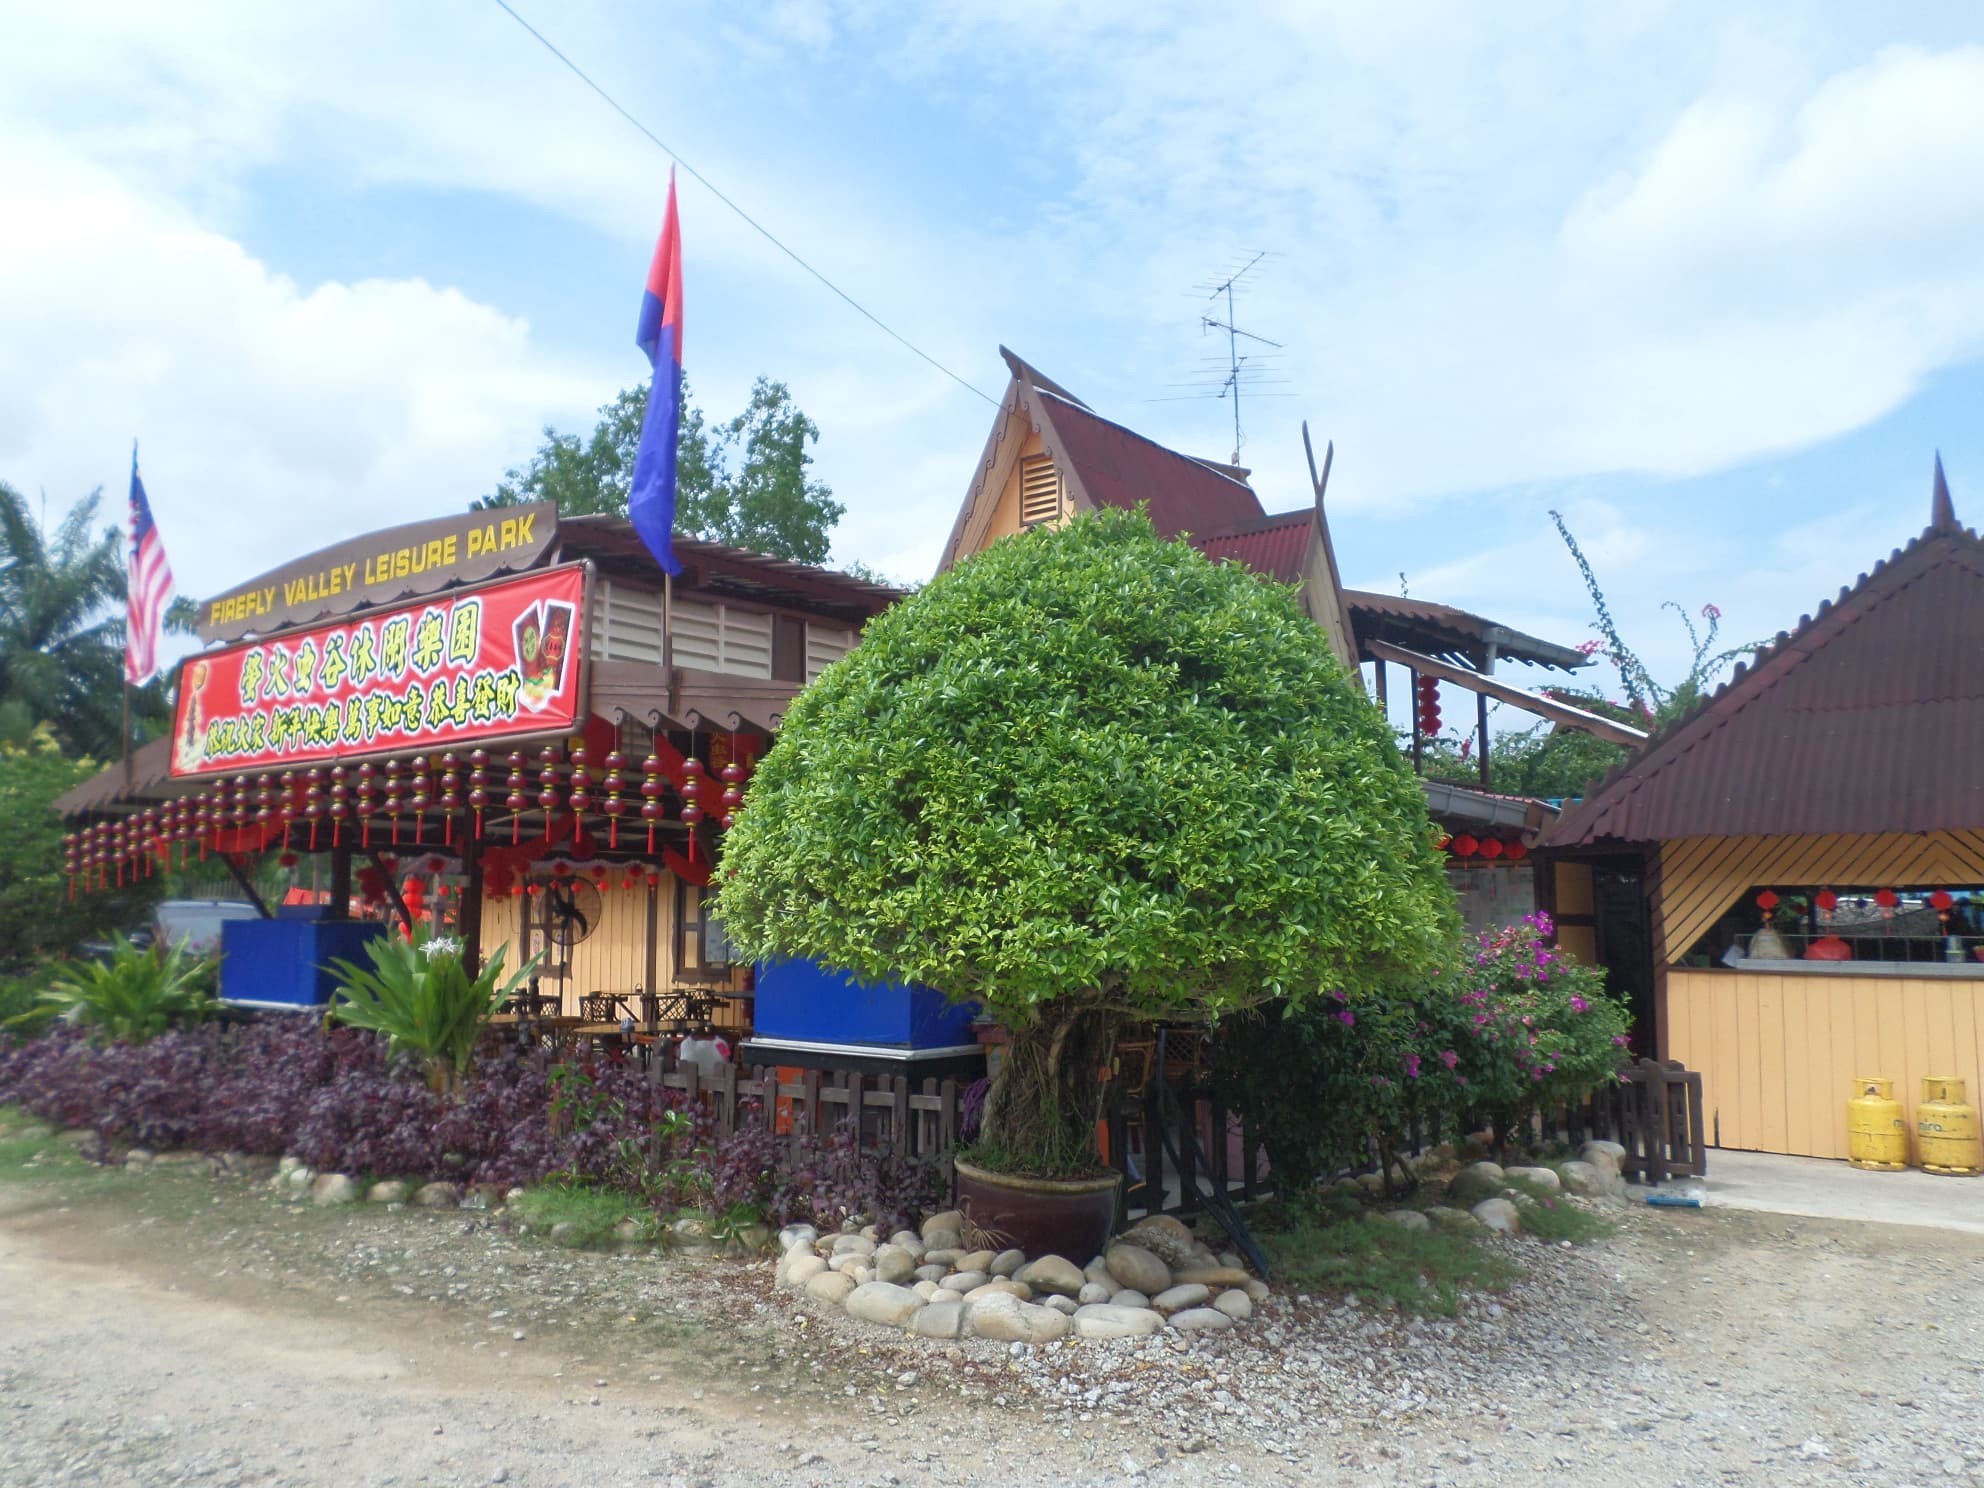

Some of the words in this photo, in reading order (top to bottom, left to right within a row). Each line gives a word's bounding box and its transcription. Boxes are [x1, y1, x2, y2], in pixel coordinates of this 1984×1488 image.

[210, 586, 276, 626] FIREFLY
[284, 562, 356, 607] VALLEY
[366, 534, 457, 585] LEISURE
[467, 512, 535, 560] PARK
[426, 670, 521, 727] 恭喜發財
